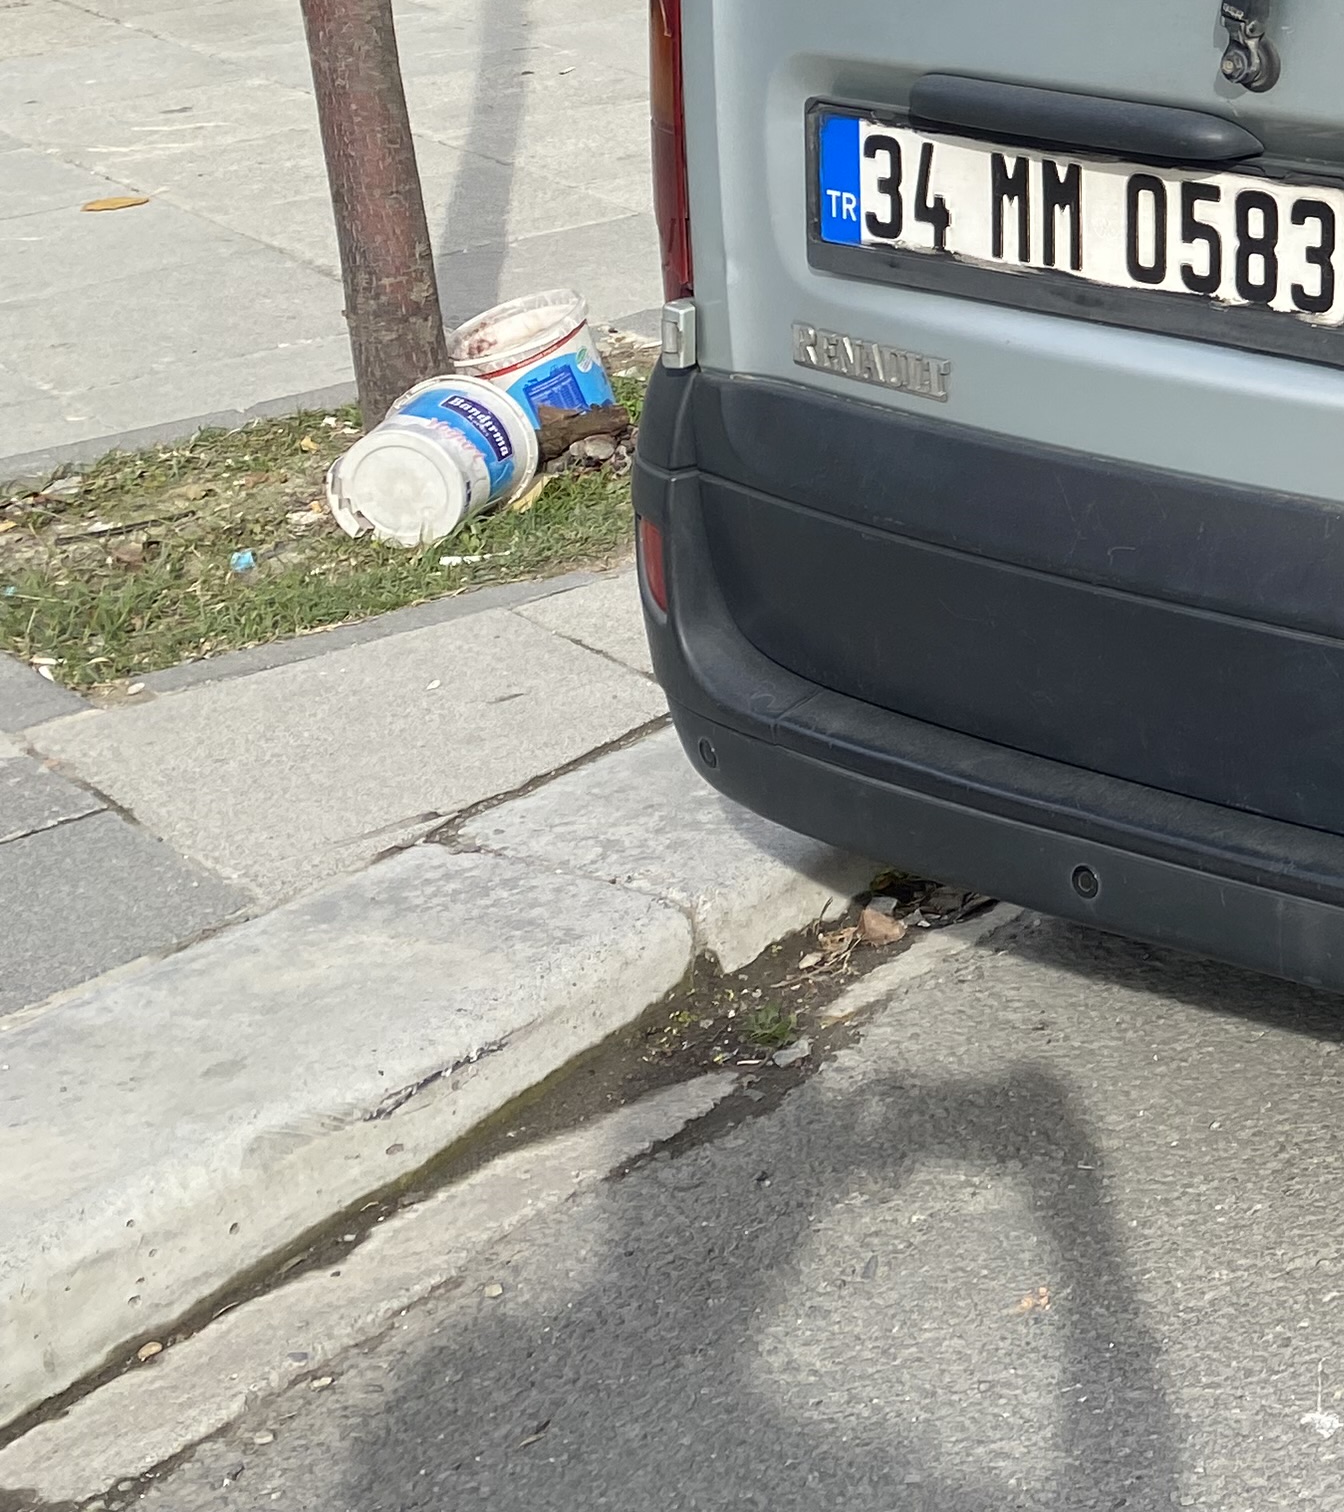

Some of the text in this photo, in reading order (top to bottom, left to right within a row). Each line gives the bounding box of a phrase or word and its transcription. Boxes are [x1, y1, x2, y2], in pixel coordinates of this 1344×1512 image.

[827, 189, 858, 222] TR
[862, 134, 1336, 314] 34 MM 0583
[791, 320, 952, 400] RENAULT
